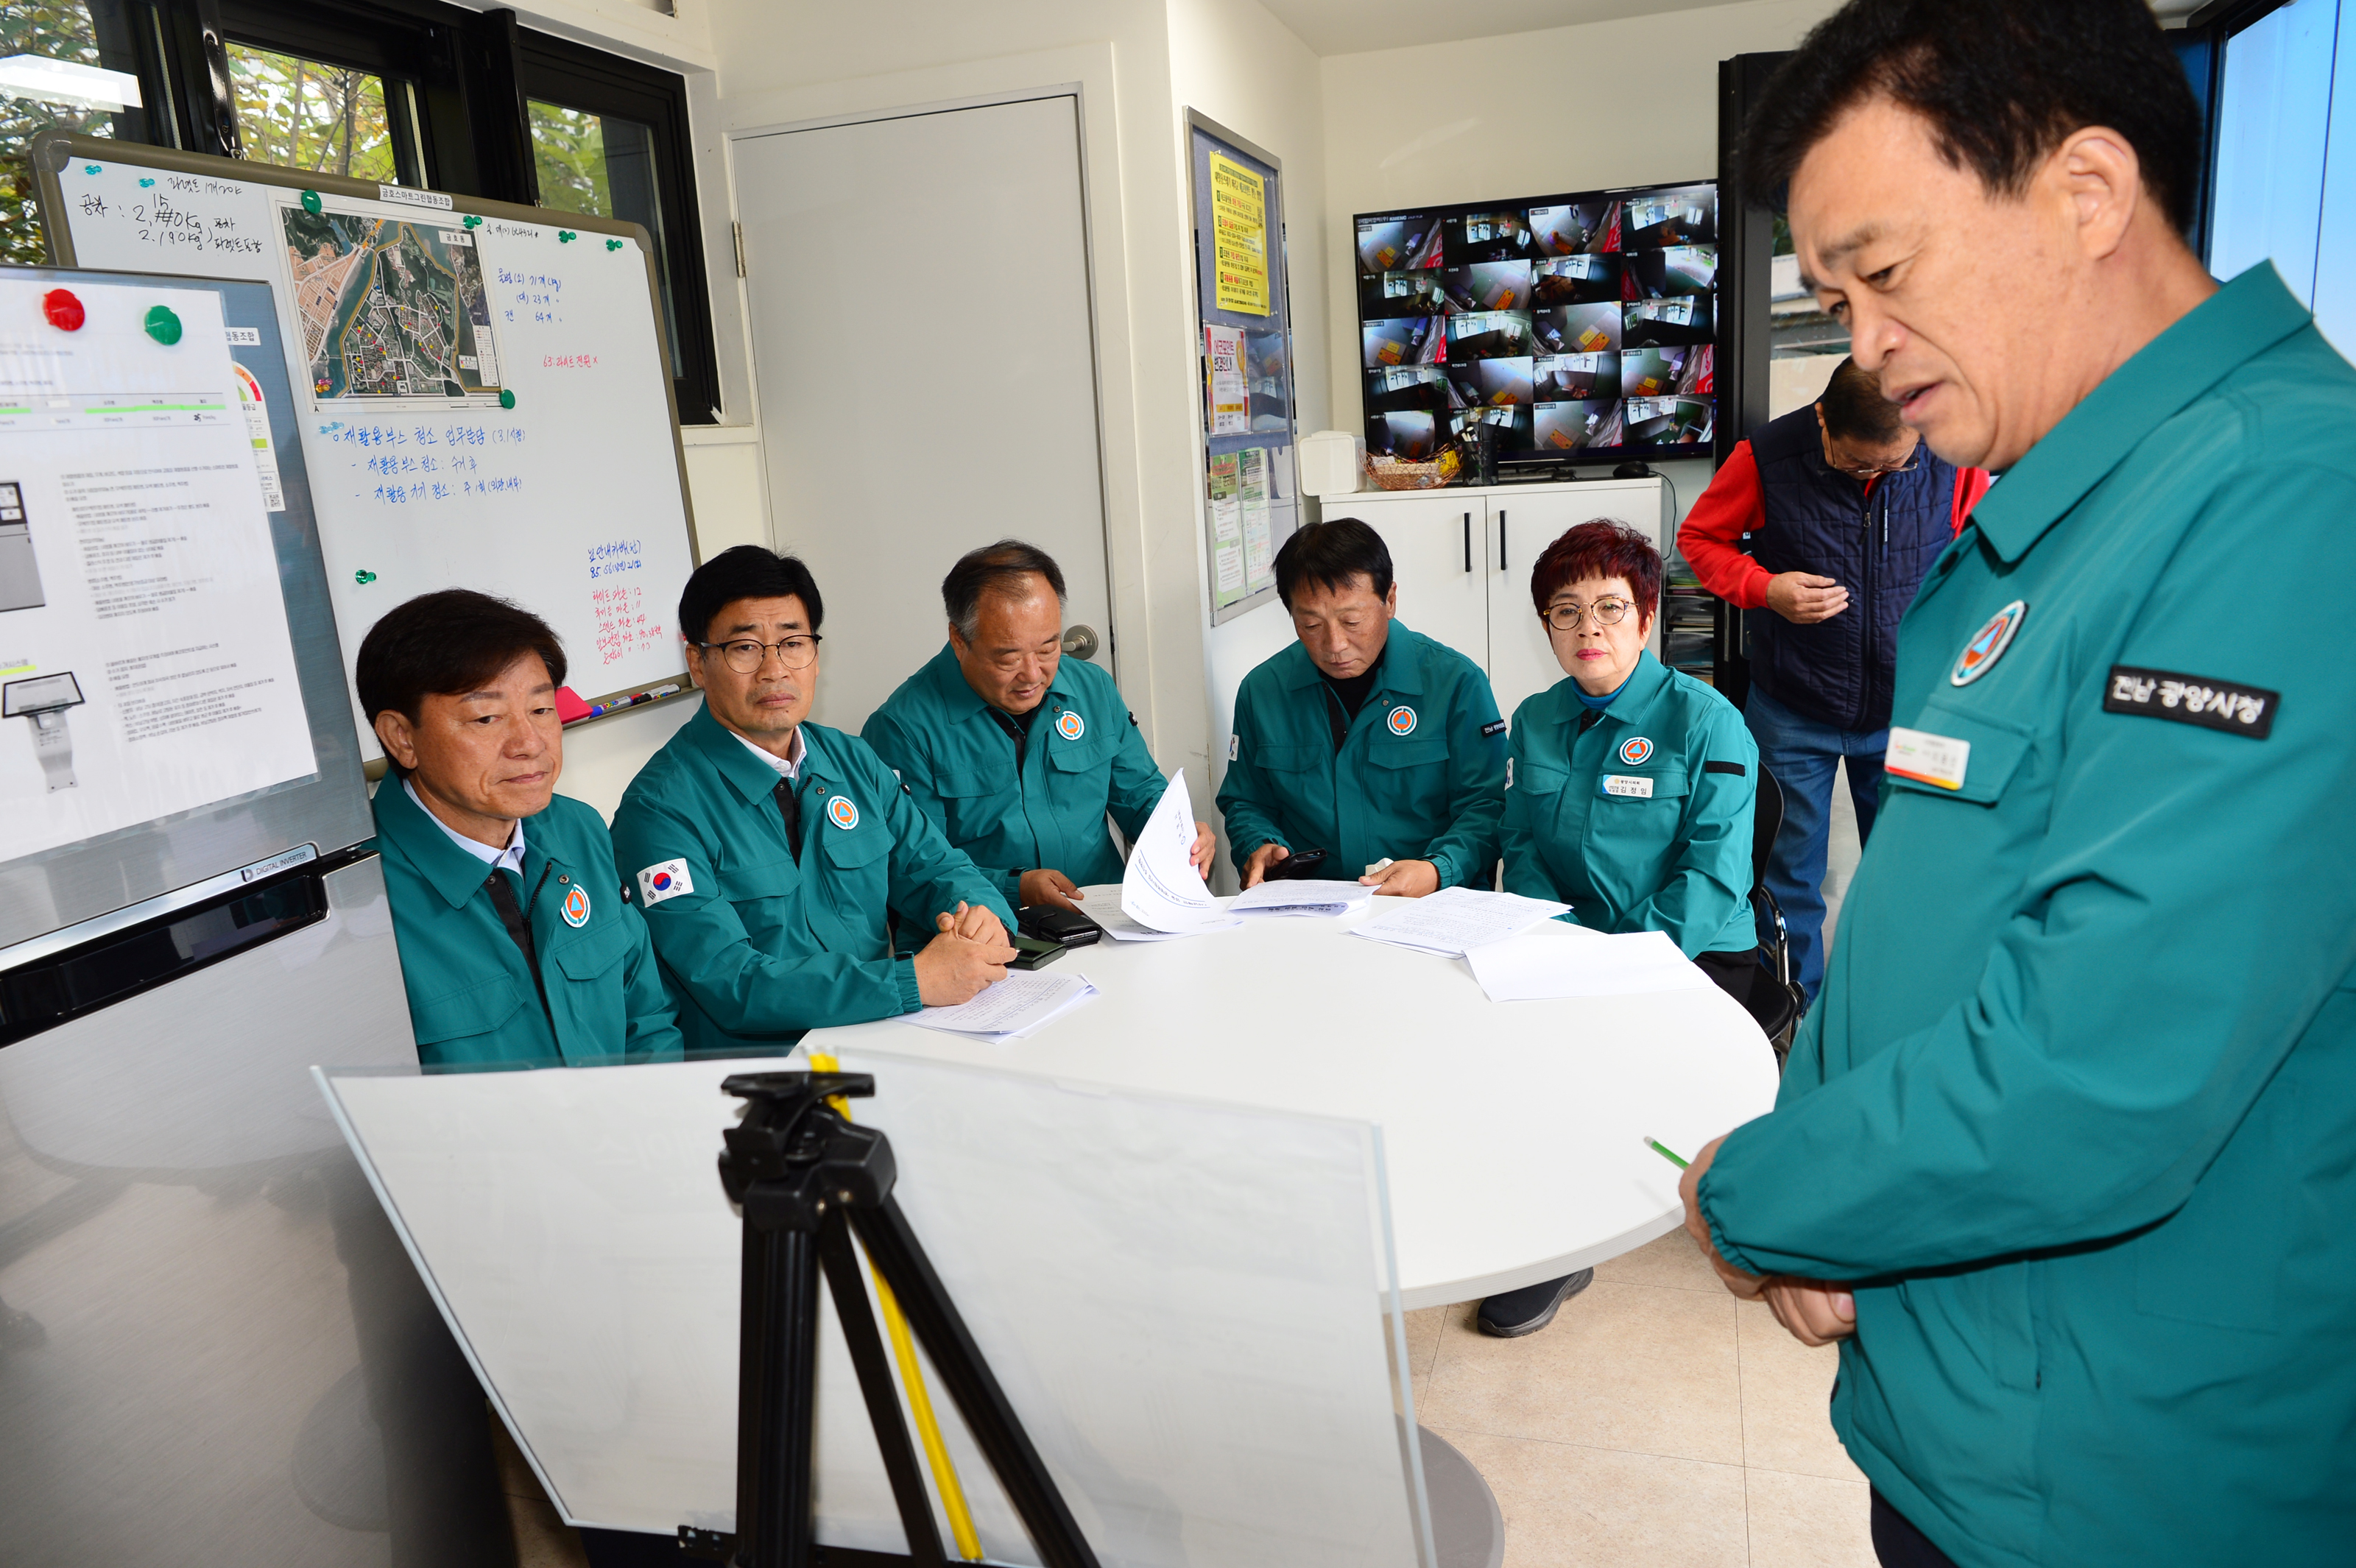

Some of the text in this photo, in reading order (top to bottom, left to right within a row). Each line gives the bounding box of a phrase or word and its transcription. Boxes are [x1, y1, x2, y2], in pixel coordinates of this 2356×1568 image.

[79, 194, 108, 218] 공차
[382, 188, 451, 206] 금호스마트그린협동조합
[1214, 339, 1235, 355] 에코포인트
[415, 425, 437, 445] 청소
[445, 425, 485, 446] 업무분담
[2112, 675, 2265, 724] 전남 광양시청
[256, 861, 279, 875] DIGITAL
[280, 851, 306, 866] INVERTER
